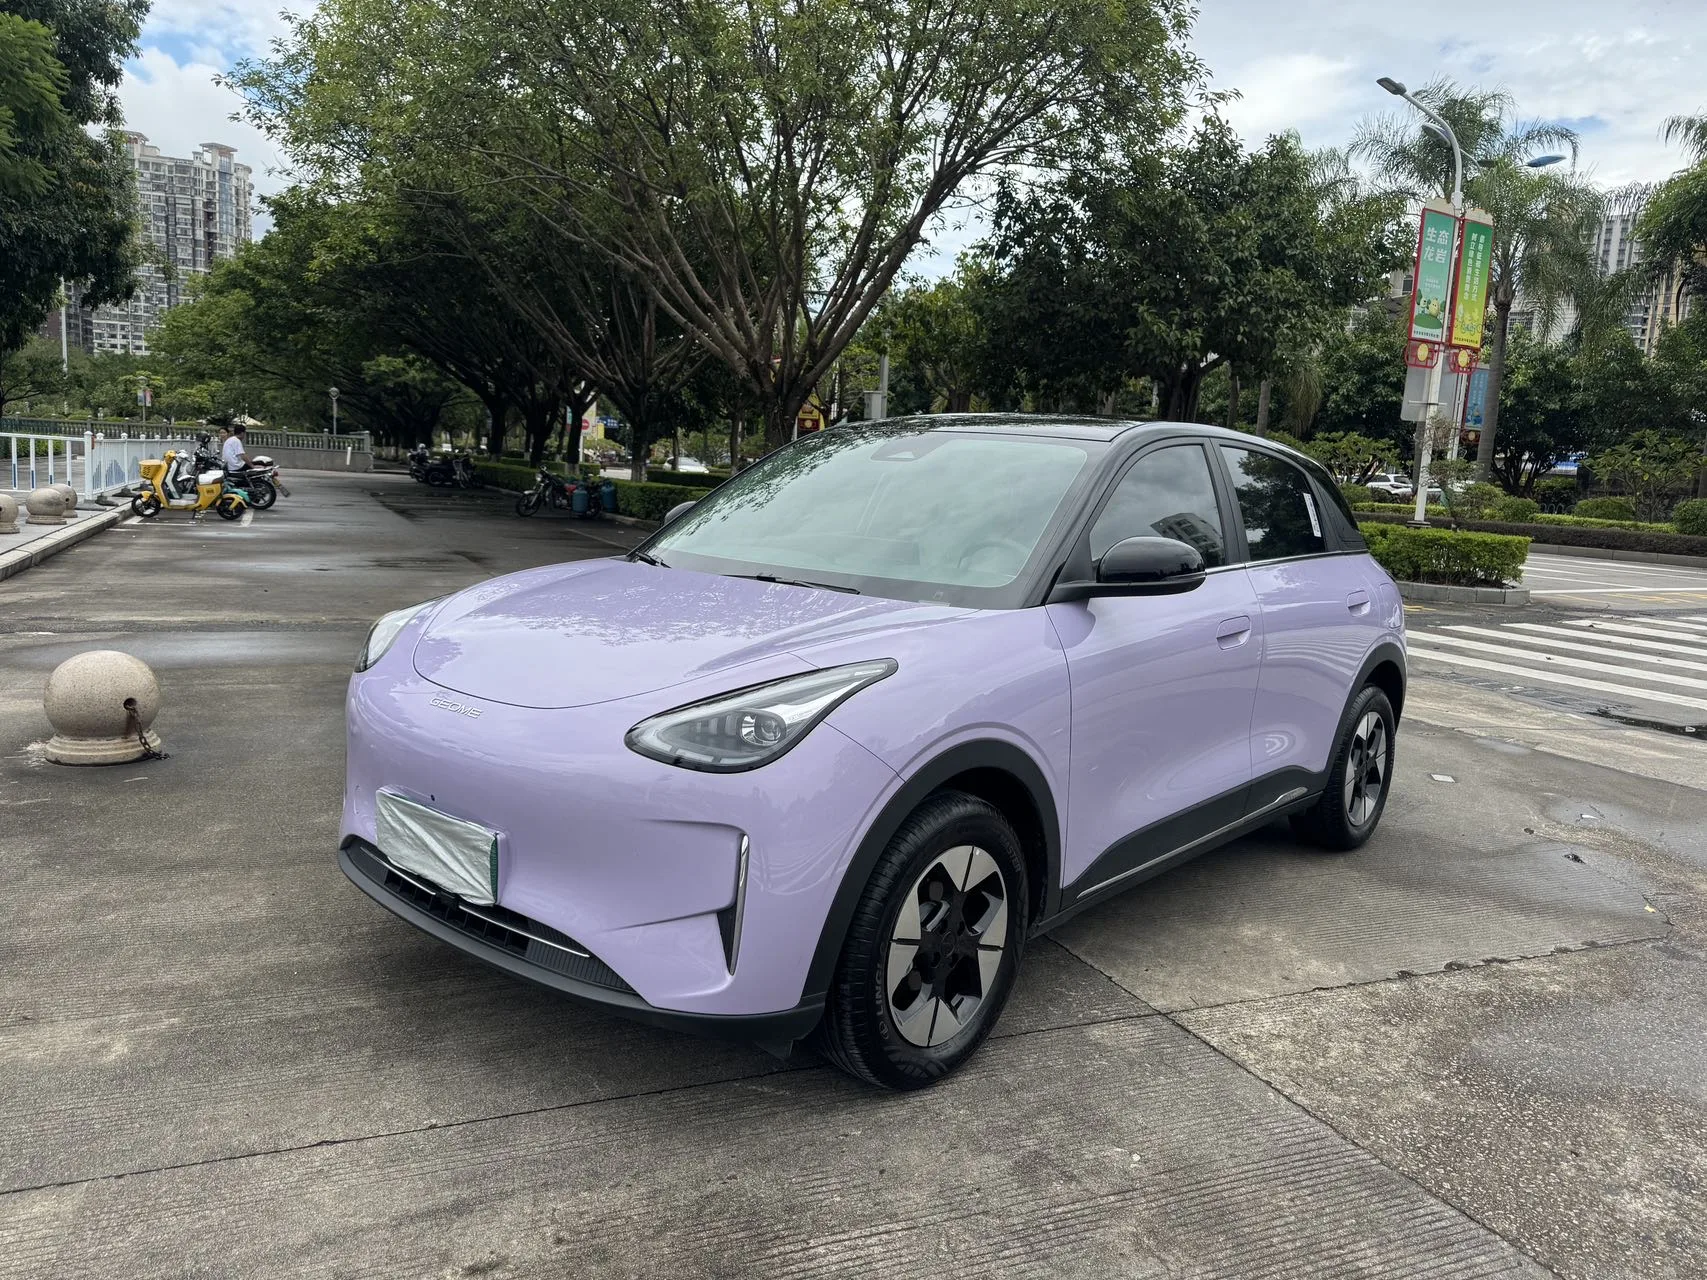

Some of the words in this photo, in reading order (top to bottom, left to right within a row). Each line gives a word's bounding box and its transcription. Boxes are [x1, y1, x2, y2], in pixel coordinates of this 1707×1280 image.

[1425, 226, 1450, 245] 生态
[1423, 245, 1448, 264] 龙岩
[430, 698, 483, 719] GEOME
